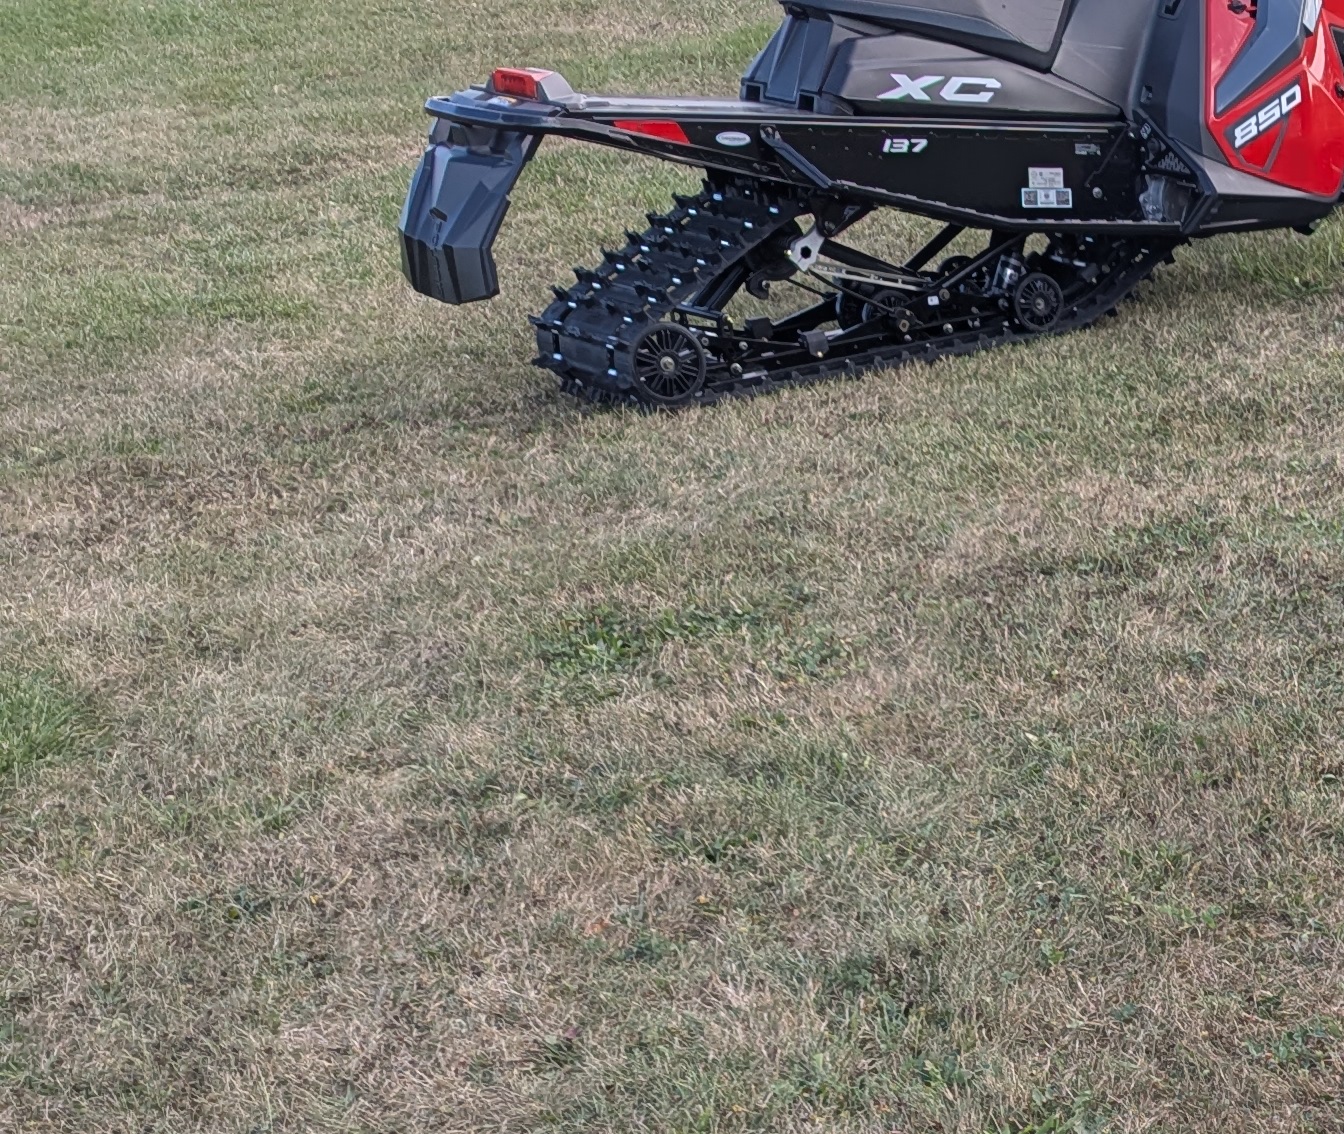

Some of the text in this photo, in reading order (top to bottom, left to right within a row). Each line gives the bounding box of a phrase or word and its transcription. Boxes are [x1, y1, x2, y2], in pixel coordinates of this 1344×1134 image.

[876, 73, 1002, 103] XC
[1234, 84, 1302, 149] 850
[882, 138, 928, 154] 137
